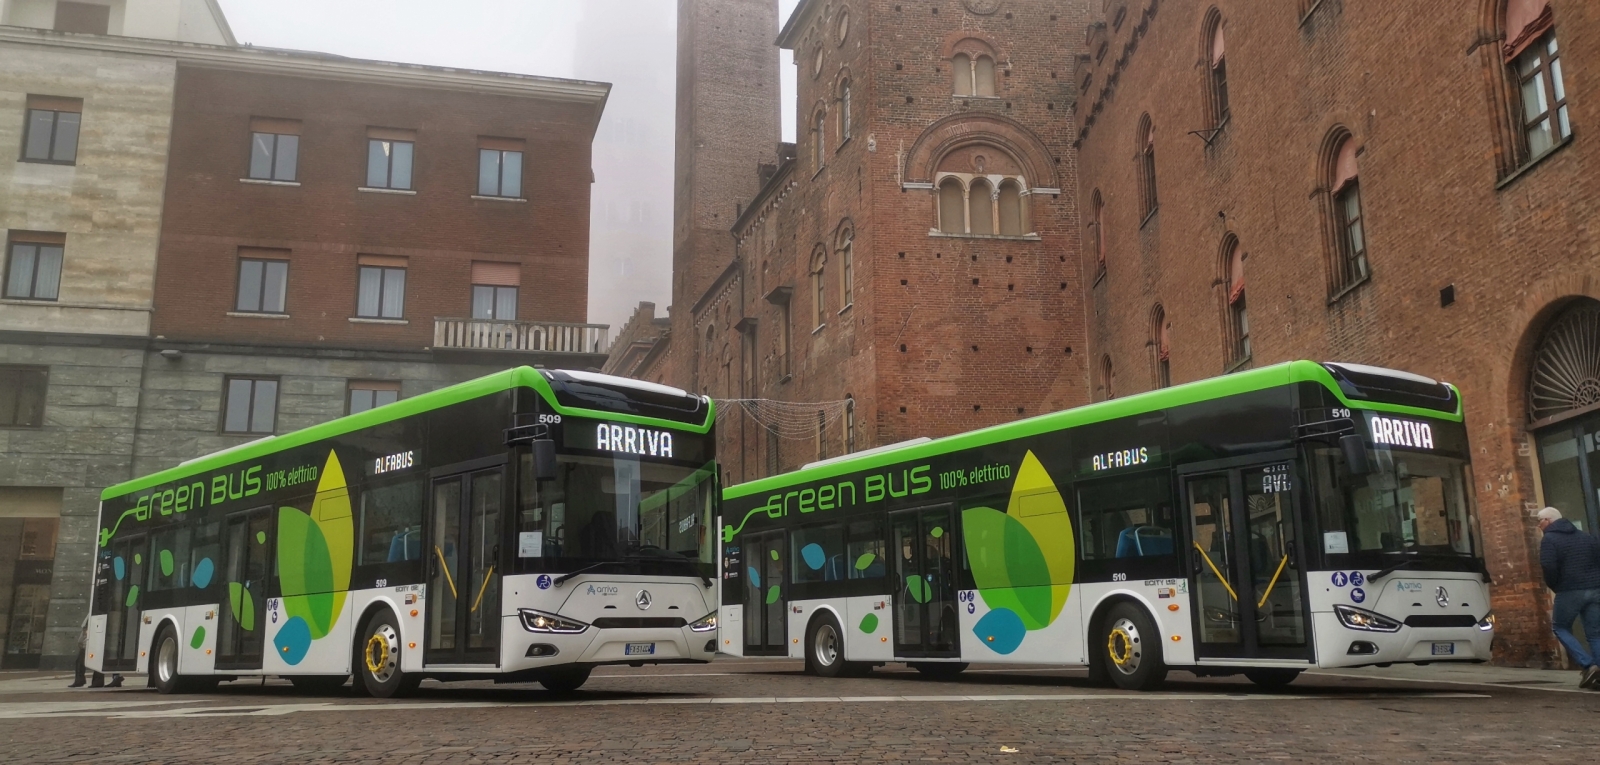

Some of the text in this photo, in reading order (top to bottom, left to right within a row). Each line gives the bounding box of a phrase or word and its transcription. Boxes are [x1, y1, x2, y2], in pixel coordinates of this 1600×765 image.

[539, 414, 562, 424] 509
[1332, 409, 1351, 418] 510
[597, 423, 673, 458] ARRIVA
[1371, 416, 1434, 449] ARRIVA
[375, 450, 413, 474] ALFABUS
[1093, 446, 1148, 471] ALFABUS
[210, 464, 262, 505] BUS
[266, 465, 317, 491] 100% elettrico
[865, 464, 932, 503] BUS
[939, 464, 1010, 490] 100% elettrico
[375, 578, 387, 587] 509
[596, 584, 618, 593] arriva
[1112, 572, 1126, 581] 510
